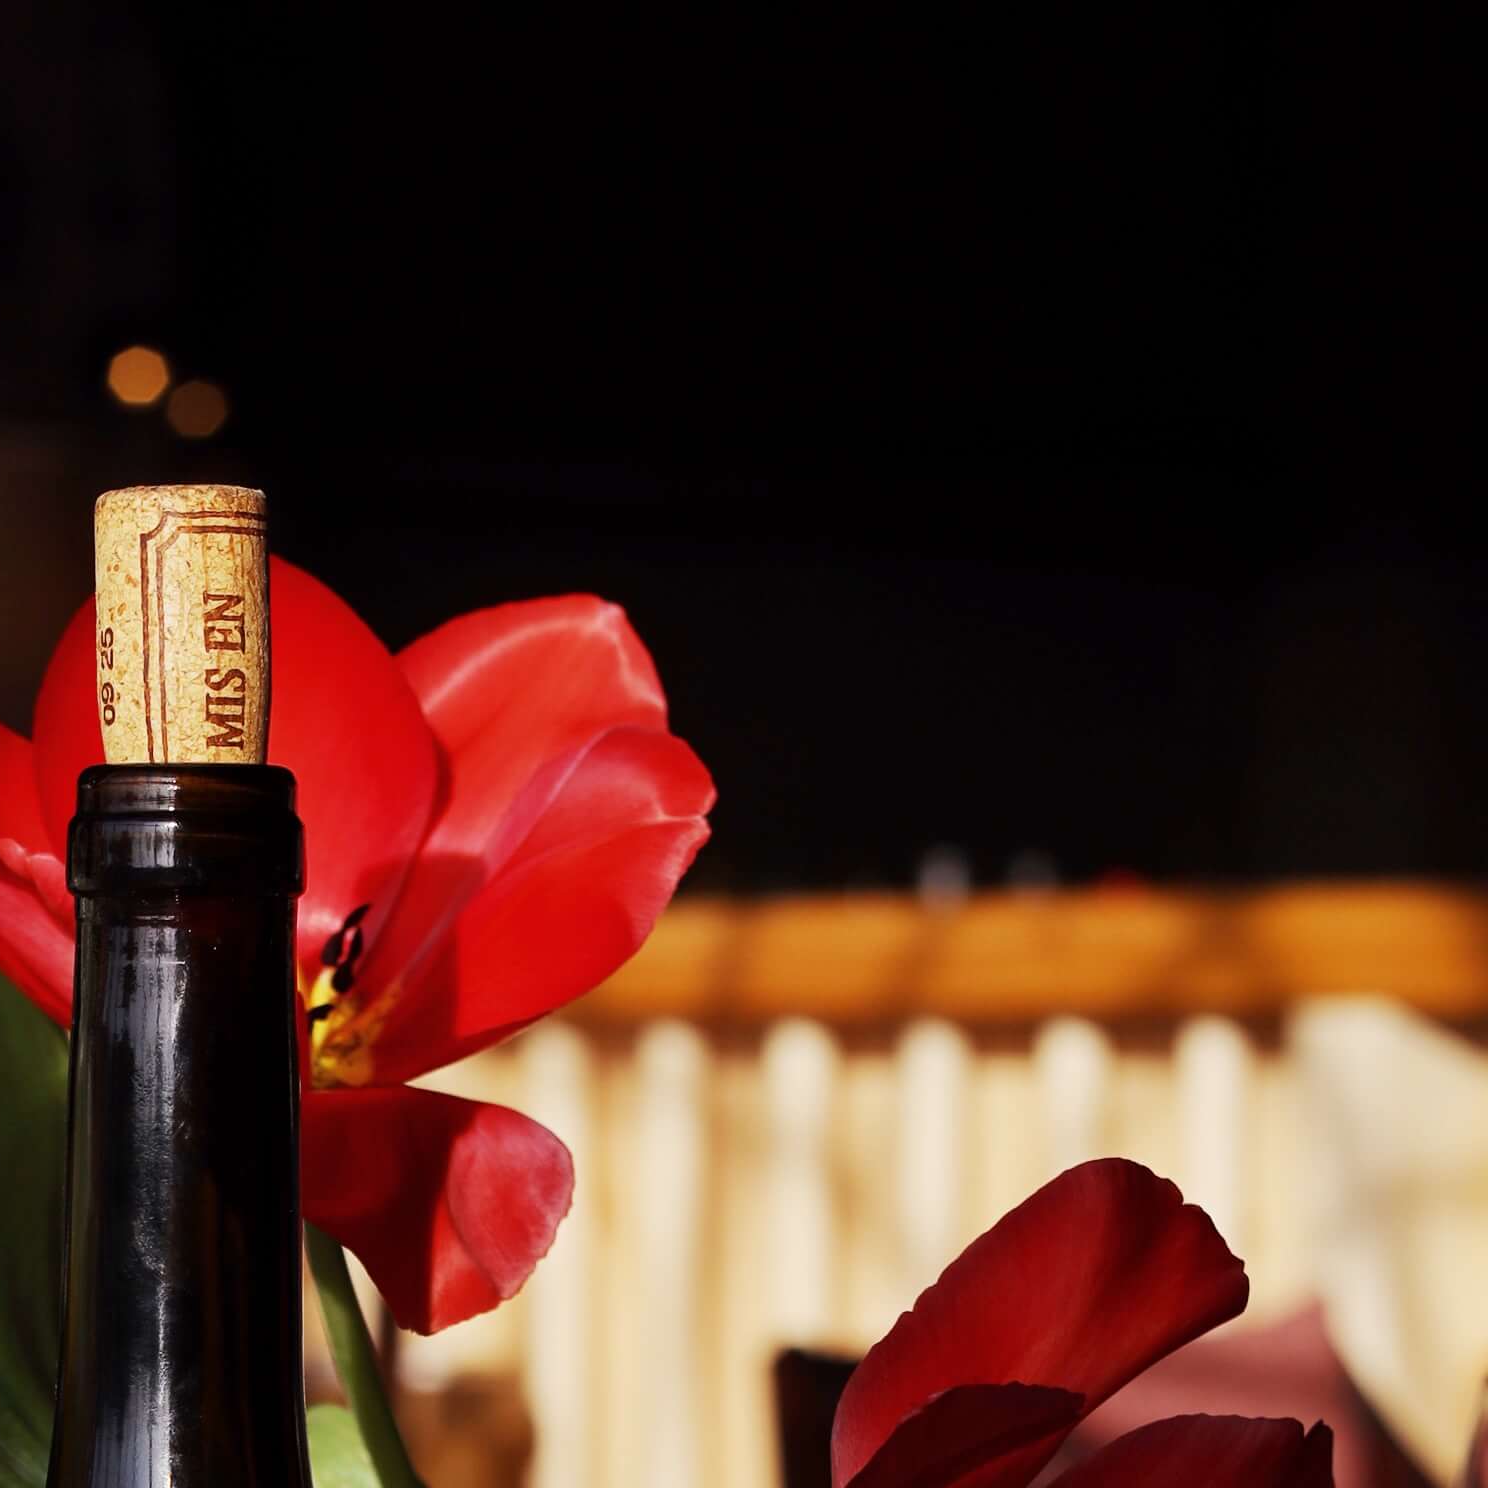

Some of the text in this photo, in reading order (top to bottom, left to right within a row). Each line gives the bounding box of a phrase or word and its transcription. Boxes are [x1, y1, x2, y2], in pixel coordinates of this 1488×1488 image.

[101, 627, 116, 726] 09 25
[203, 590, 246, 750] MIS EN
